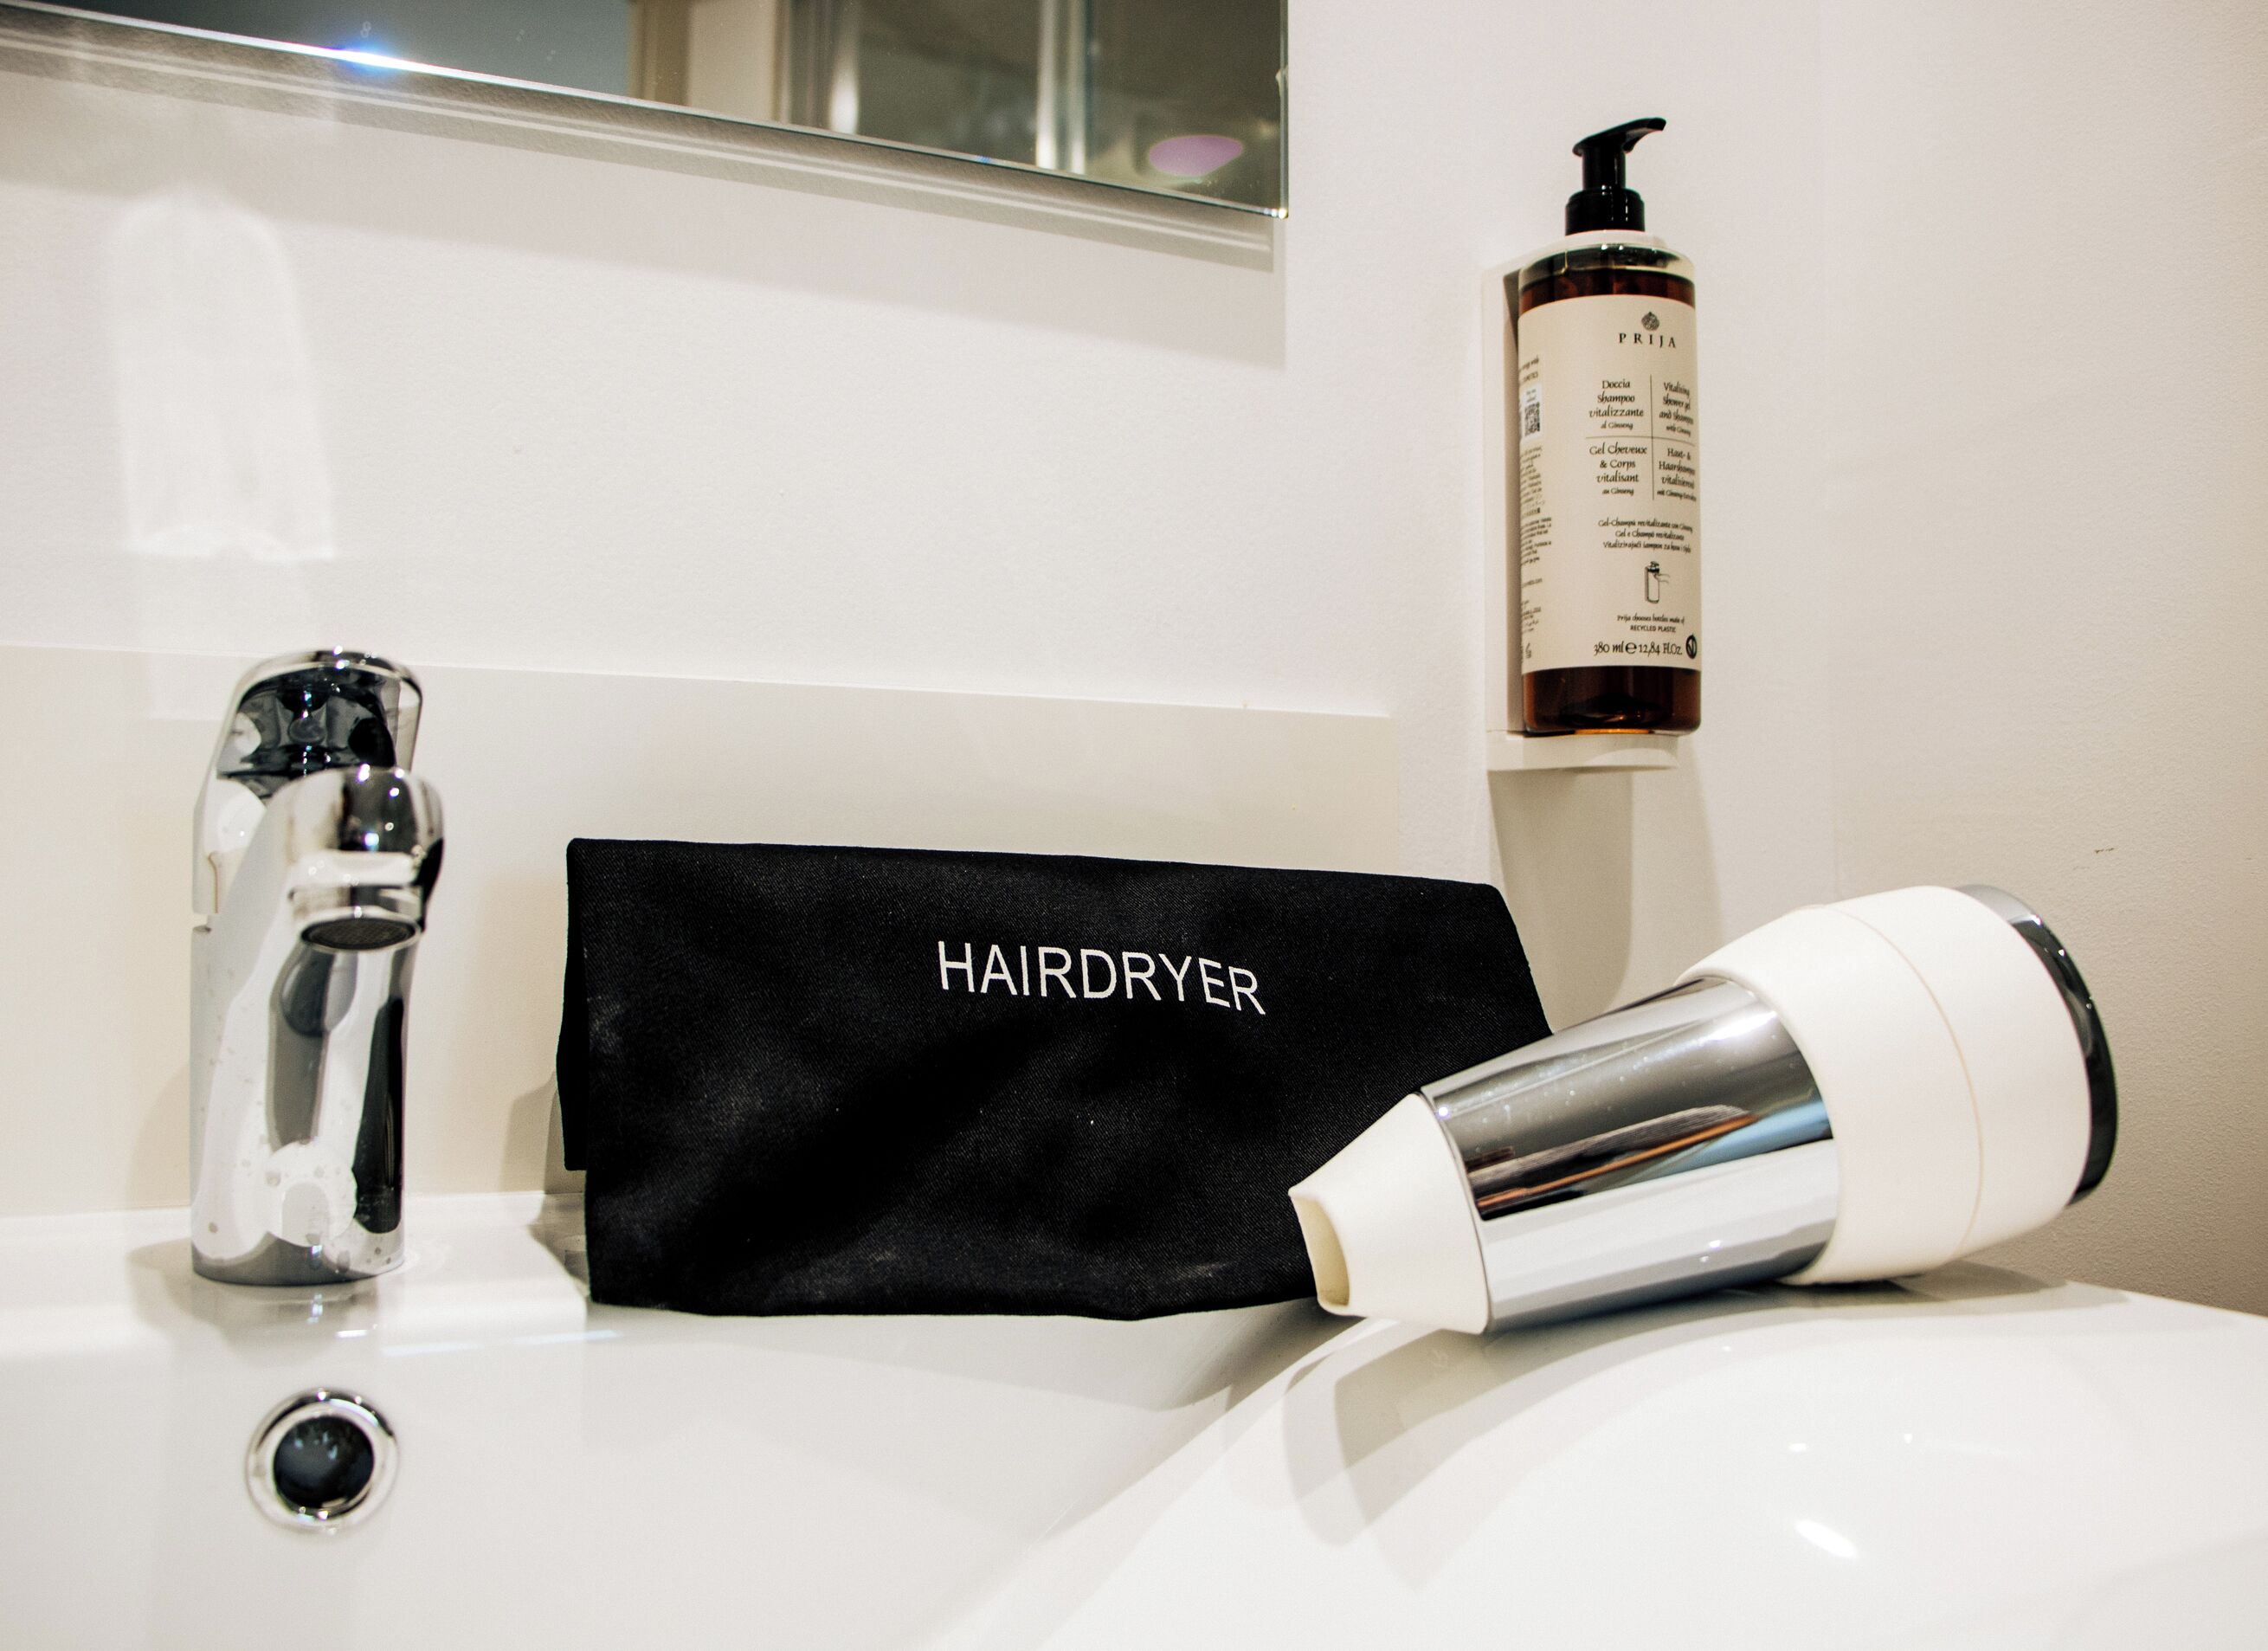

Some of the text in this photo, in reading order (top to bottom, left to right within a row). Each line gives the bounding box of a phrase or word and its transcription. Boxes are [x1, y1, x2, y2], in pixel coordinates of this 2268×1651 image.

[1618, 332, 1676, 348] PRIJA
[1601, 378, 1631, 389] Doccia
[1588, 403, 1644, 417] vitalizzante
[1589, 442, 1648, 455] Gel Cheveux
[1599, 459, 1636, 471] & Corps
[1596, 469, 1640, 483] vitalisant
[1657, 625, 1677, 634] PLASTIC
[1594, 641, 1611, 657] 380
[1612, 641, 1625, 654] ml
[1639, 641, 1661, 658] 12,84
[937, 940, 1266, 1016] HAIRDRYER
